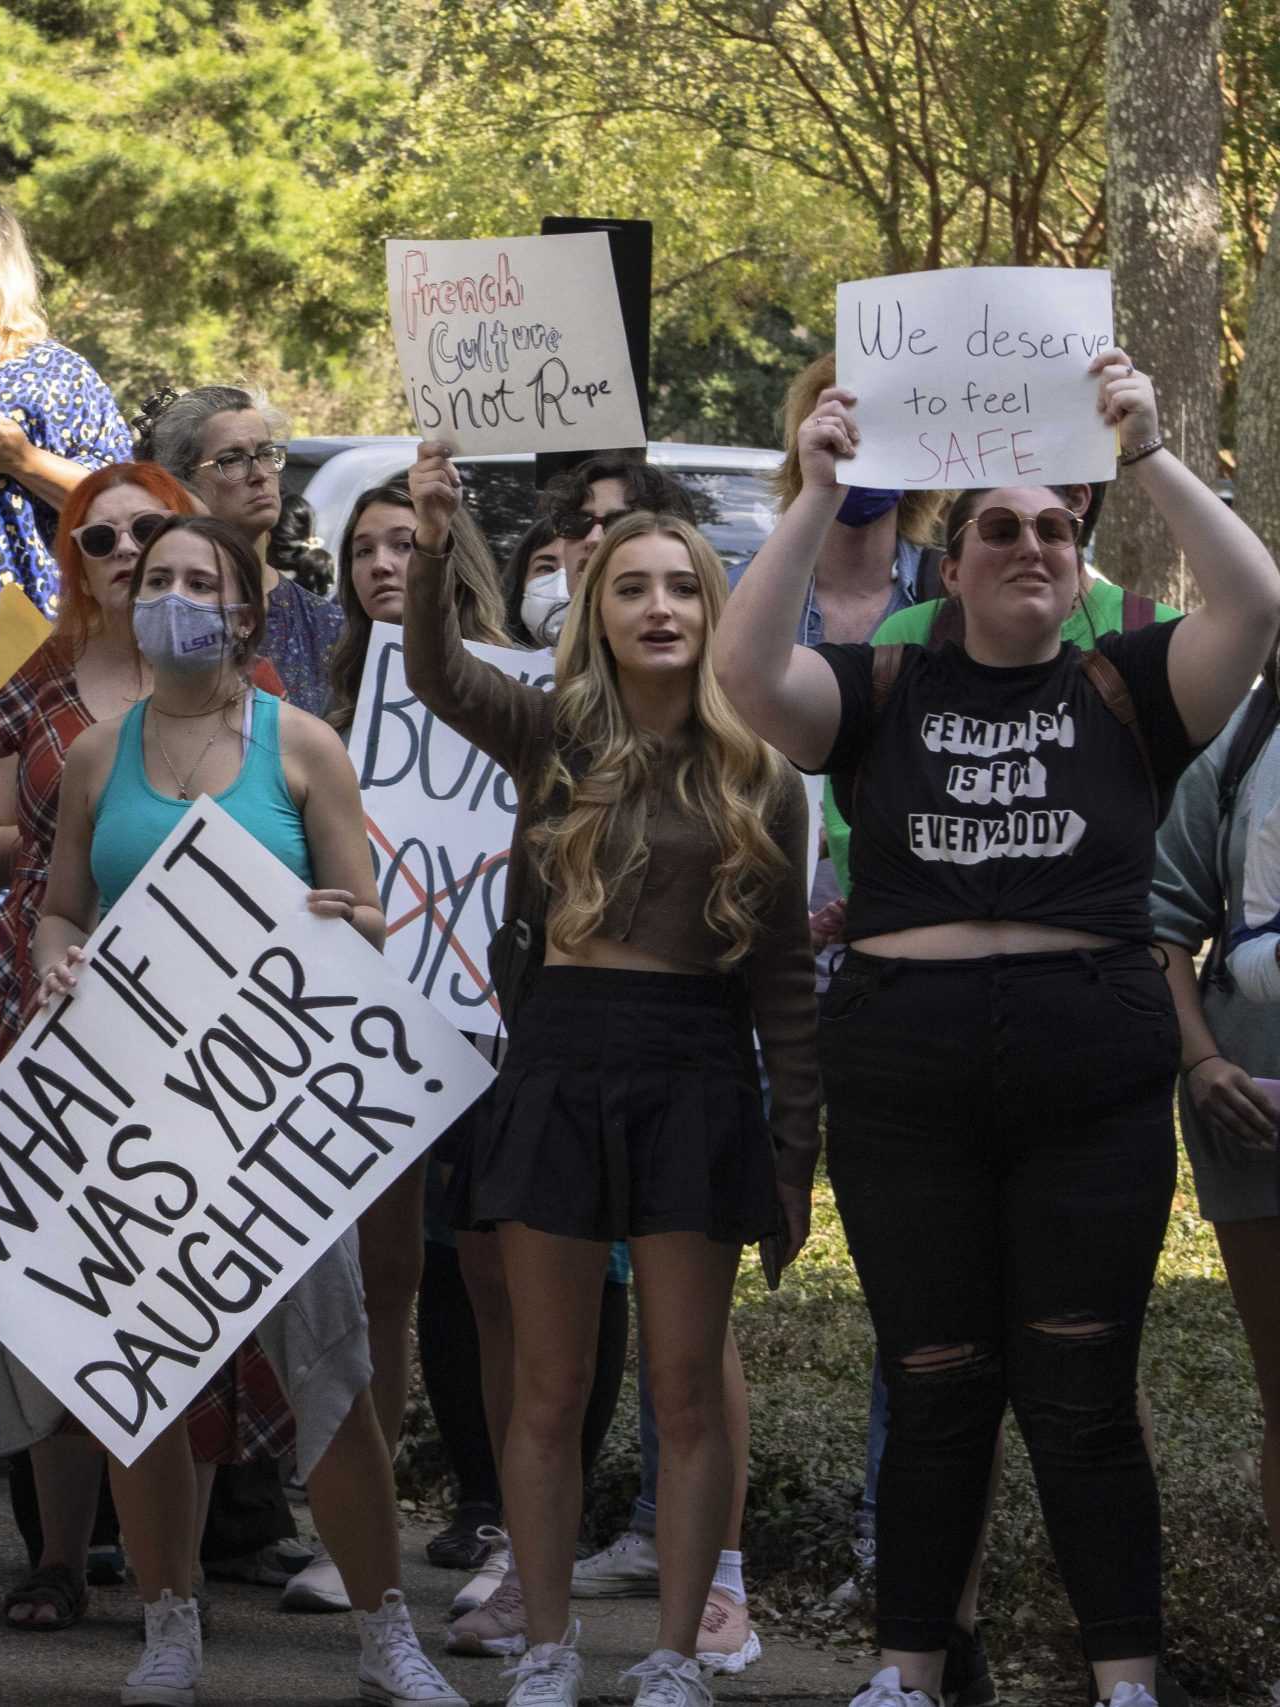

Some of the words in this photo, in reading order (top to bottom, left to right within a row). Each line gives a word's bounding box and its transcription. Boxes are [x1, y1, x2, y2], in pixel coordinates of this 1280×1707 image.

[401, 250, 524, 341] French
[428, 320, 562, 387] Culture
[858, 299, 939, 361] We
[449, 379, 525, 430] not
[527, 357, 612, 430] Rape
[904, 387, 948, 416] to
[962, 381, 1031, 415] feel
[904, 428, 1043, 483] SAFE
[181, 633, 217, 653] LSU
[948, 765, 980, 796] IS
[990, 758, 1040, 797] FO
[909, 809, 1078, 859] EVERYBODY
[90, 925, 188, 1049] IF
[146, 817, 278, 979] IT
[23, 1124, 199, 1318] WAS
[163, 946, 359, 1153] YOUR
[73, 1004, 444, 1437] DAUGHTER?
